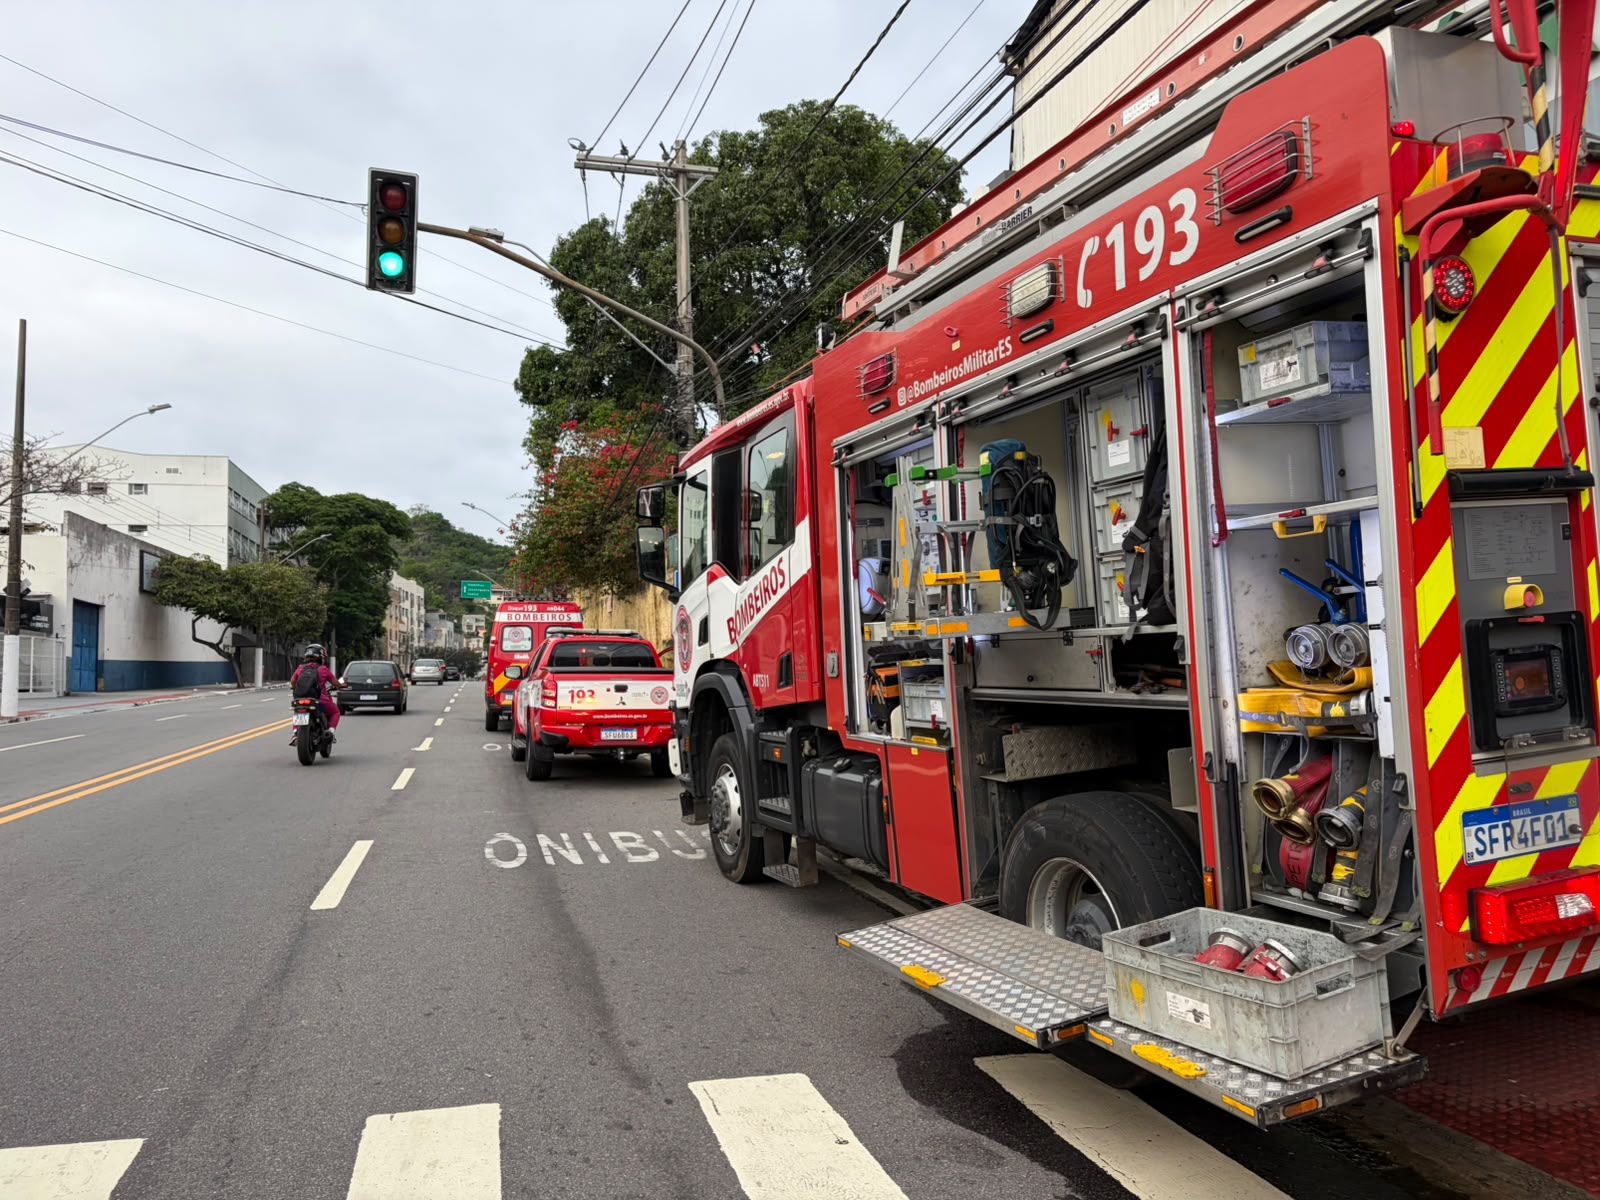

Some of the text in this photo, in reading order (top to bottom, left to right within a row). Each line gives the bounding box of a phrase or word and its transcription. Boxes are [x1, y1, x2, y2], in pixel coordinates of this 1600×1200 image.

[1105, 188, 1199, 291] 193
[907, 336, 1012, 402] @BombeirosMilitarES
[507, 613, 572, 621] BOMBEIROS
[726, 556, 786, 645] BOMBEIROS
[568, 689, 596, 704] 193
[1512, 807, 1532, 817] BRASIL
